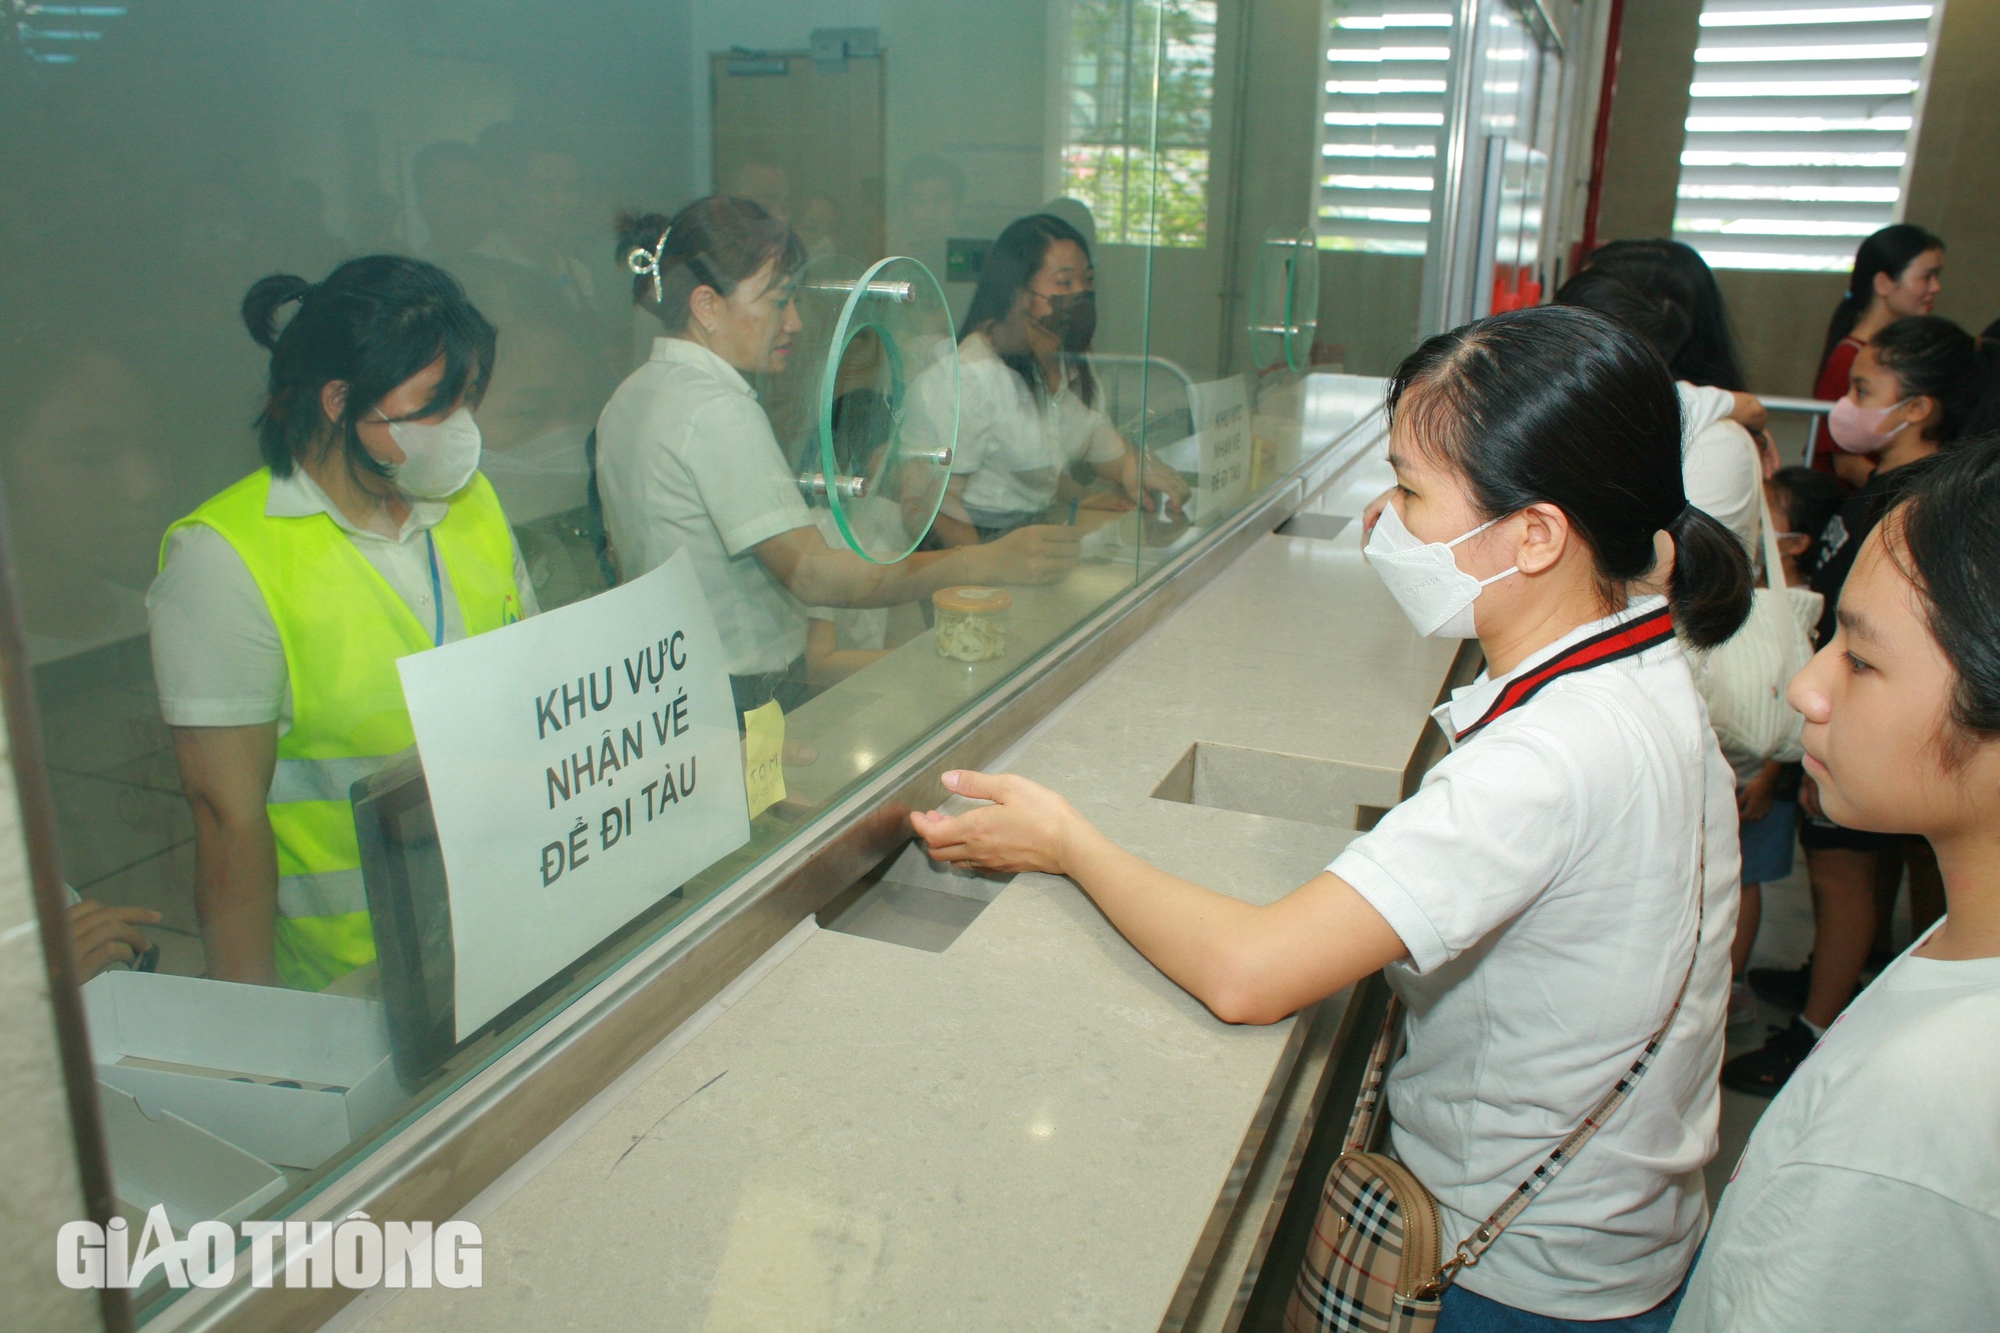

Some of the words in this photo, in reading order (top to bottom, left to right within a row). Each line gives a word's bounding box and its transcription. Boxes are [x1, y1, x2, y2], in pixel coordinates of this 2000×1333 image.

[535, 665, 613, 740] KHU
[624, 630, 687, 694] VỰC
[546, 720, 643, 810] NHẬN
[652, 686, 689, 746] VÉ
[540, 816, 590, 888] ĐỂ
[600, 797, 631, 852] ĐI
[641, 755, 696, 822] TÀU
